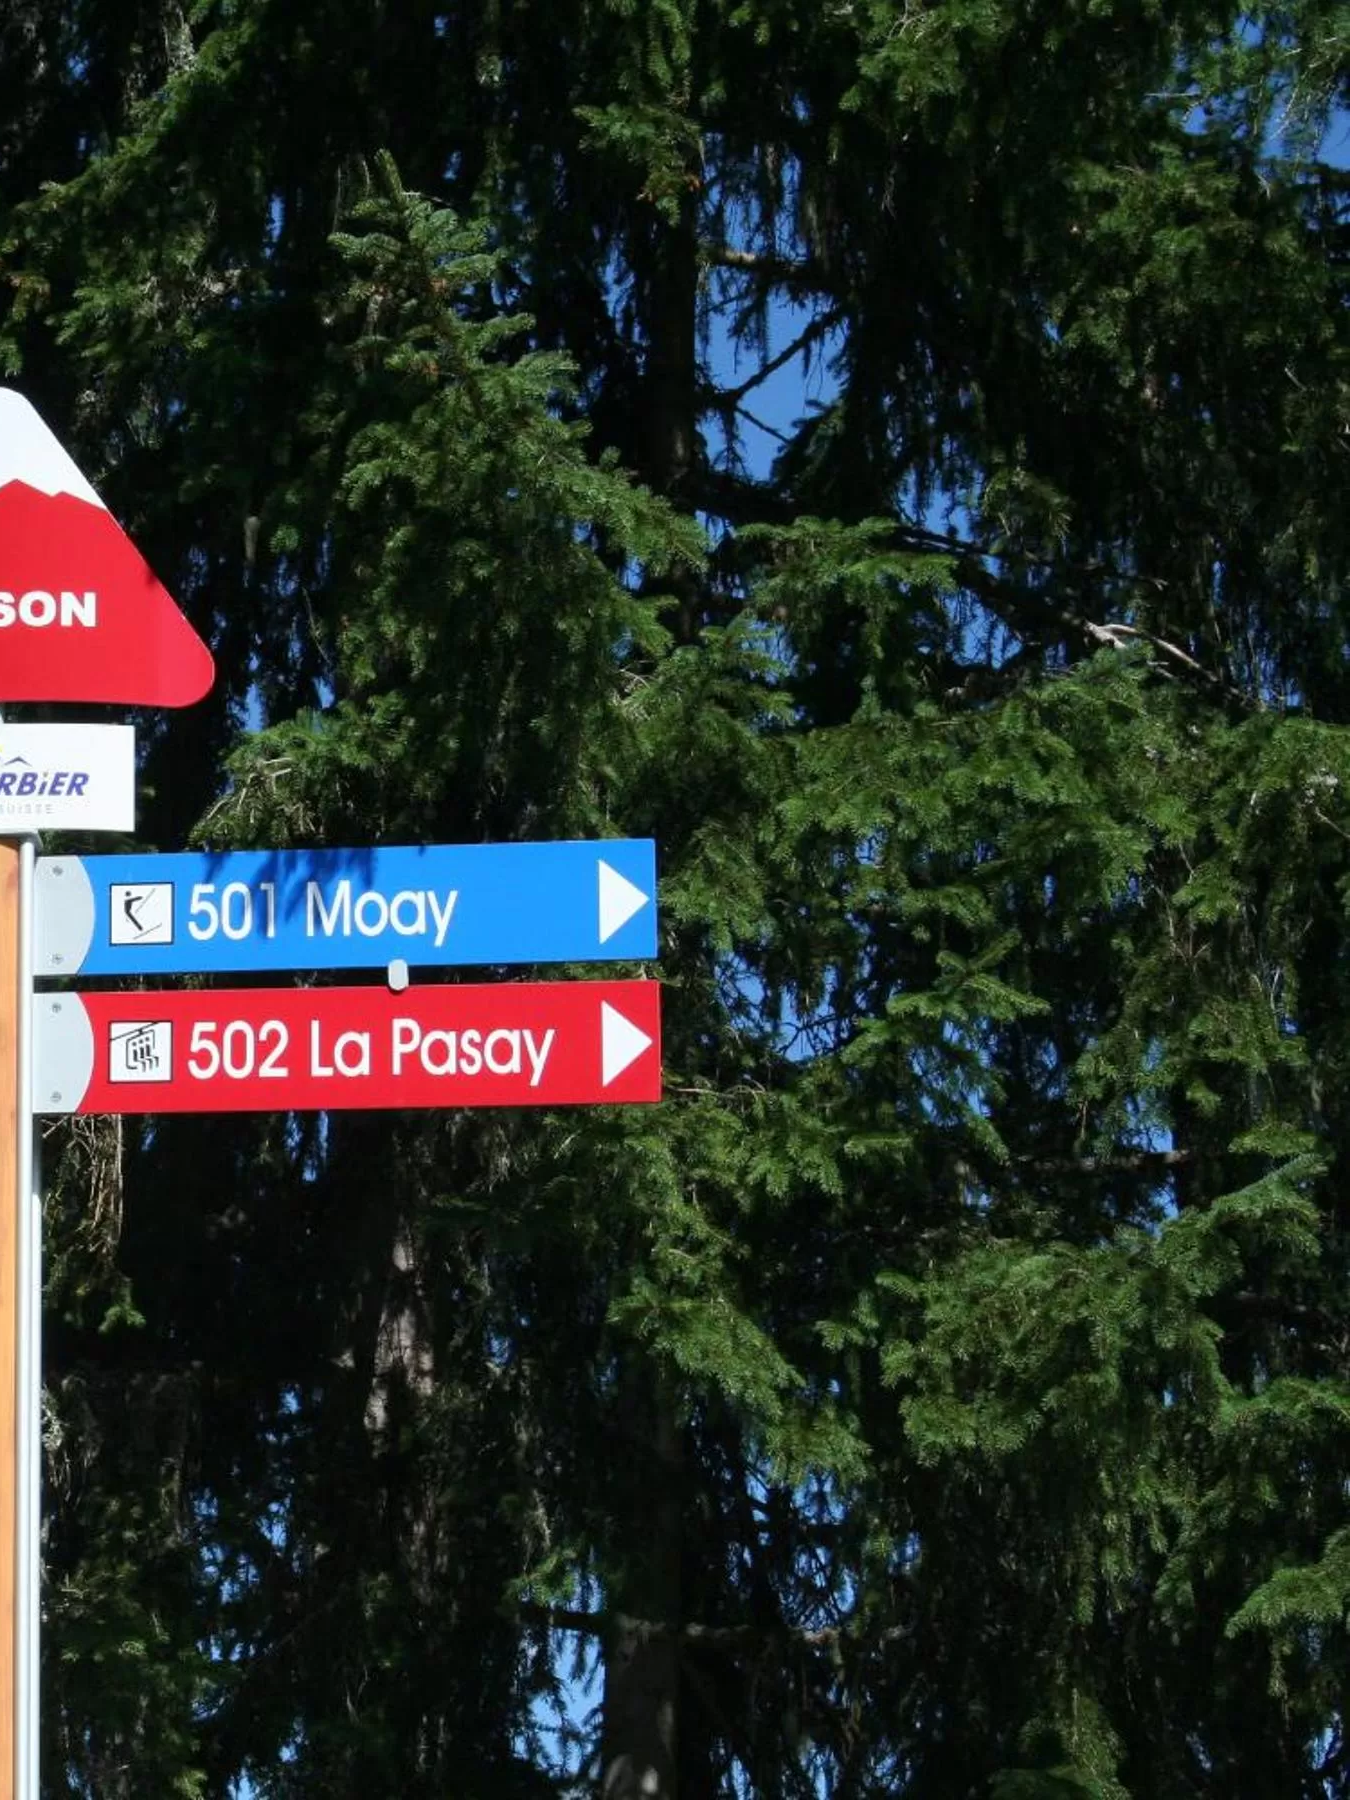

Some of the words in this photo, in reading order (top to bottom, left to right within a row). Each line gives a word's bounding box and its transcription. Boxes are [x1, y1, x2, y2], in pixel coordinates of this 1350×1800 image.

[188, 882, 276, 939] 501
[306, 878, 459, 946] Moay
[188, 1019, 289, 1079] 502
[311, 1019, 369, 1077] La
[392, 1018, 554, 1086] Pasay
